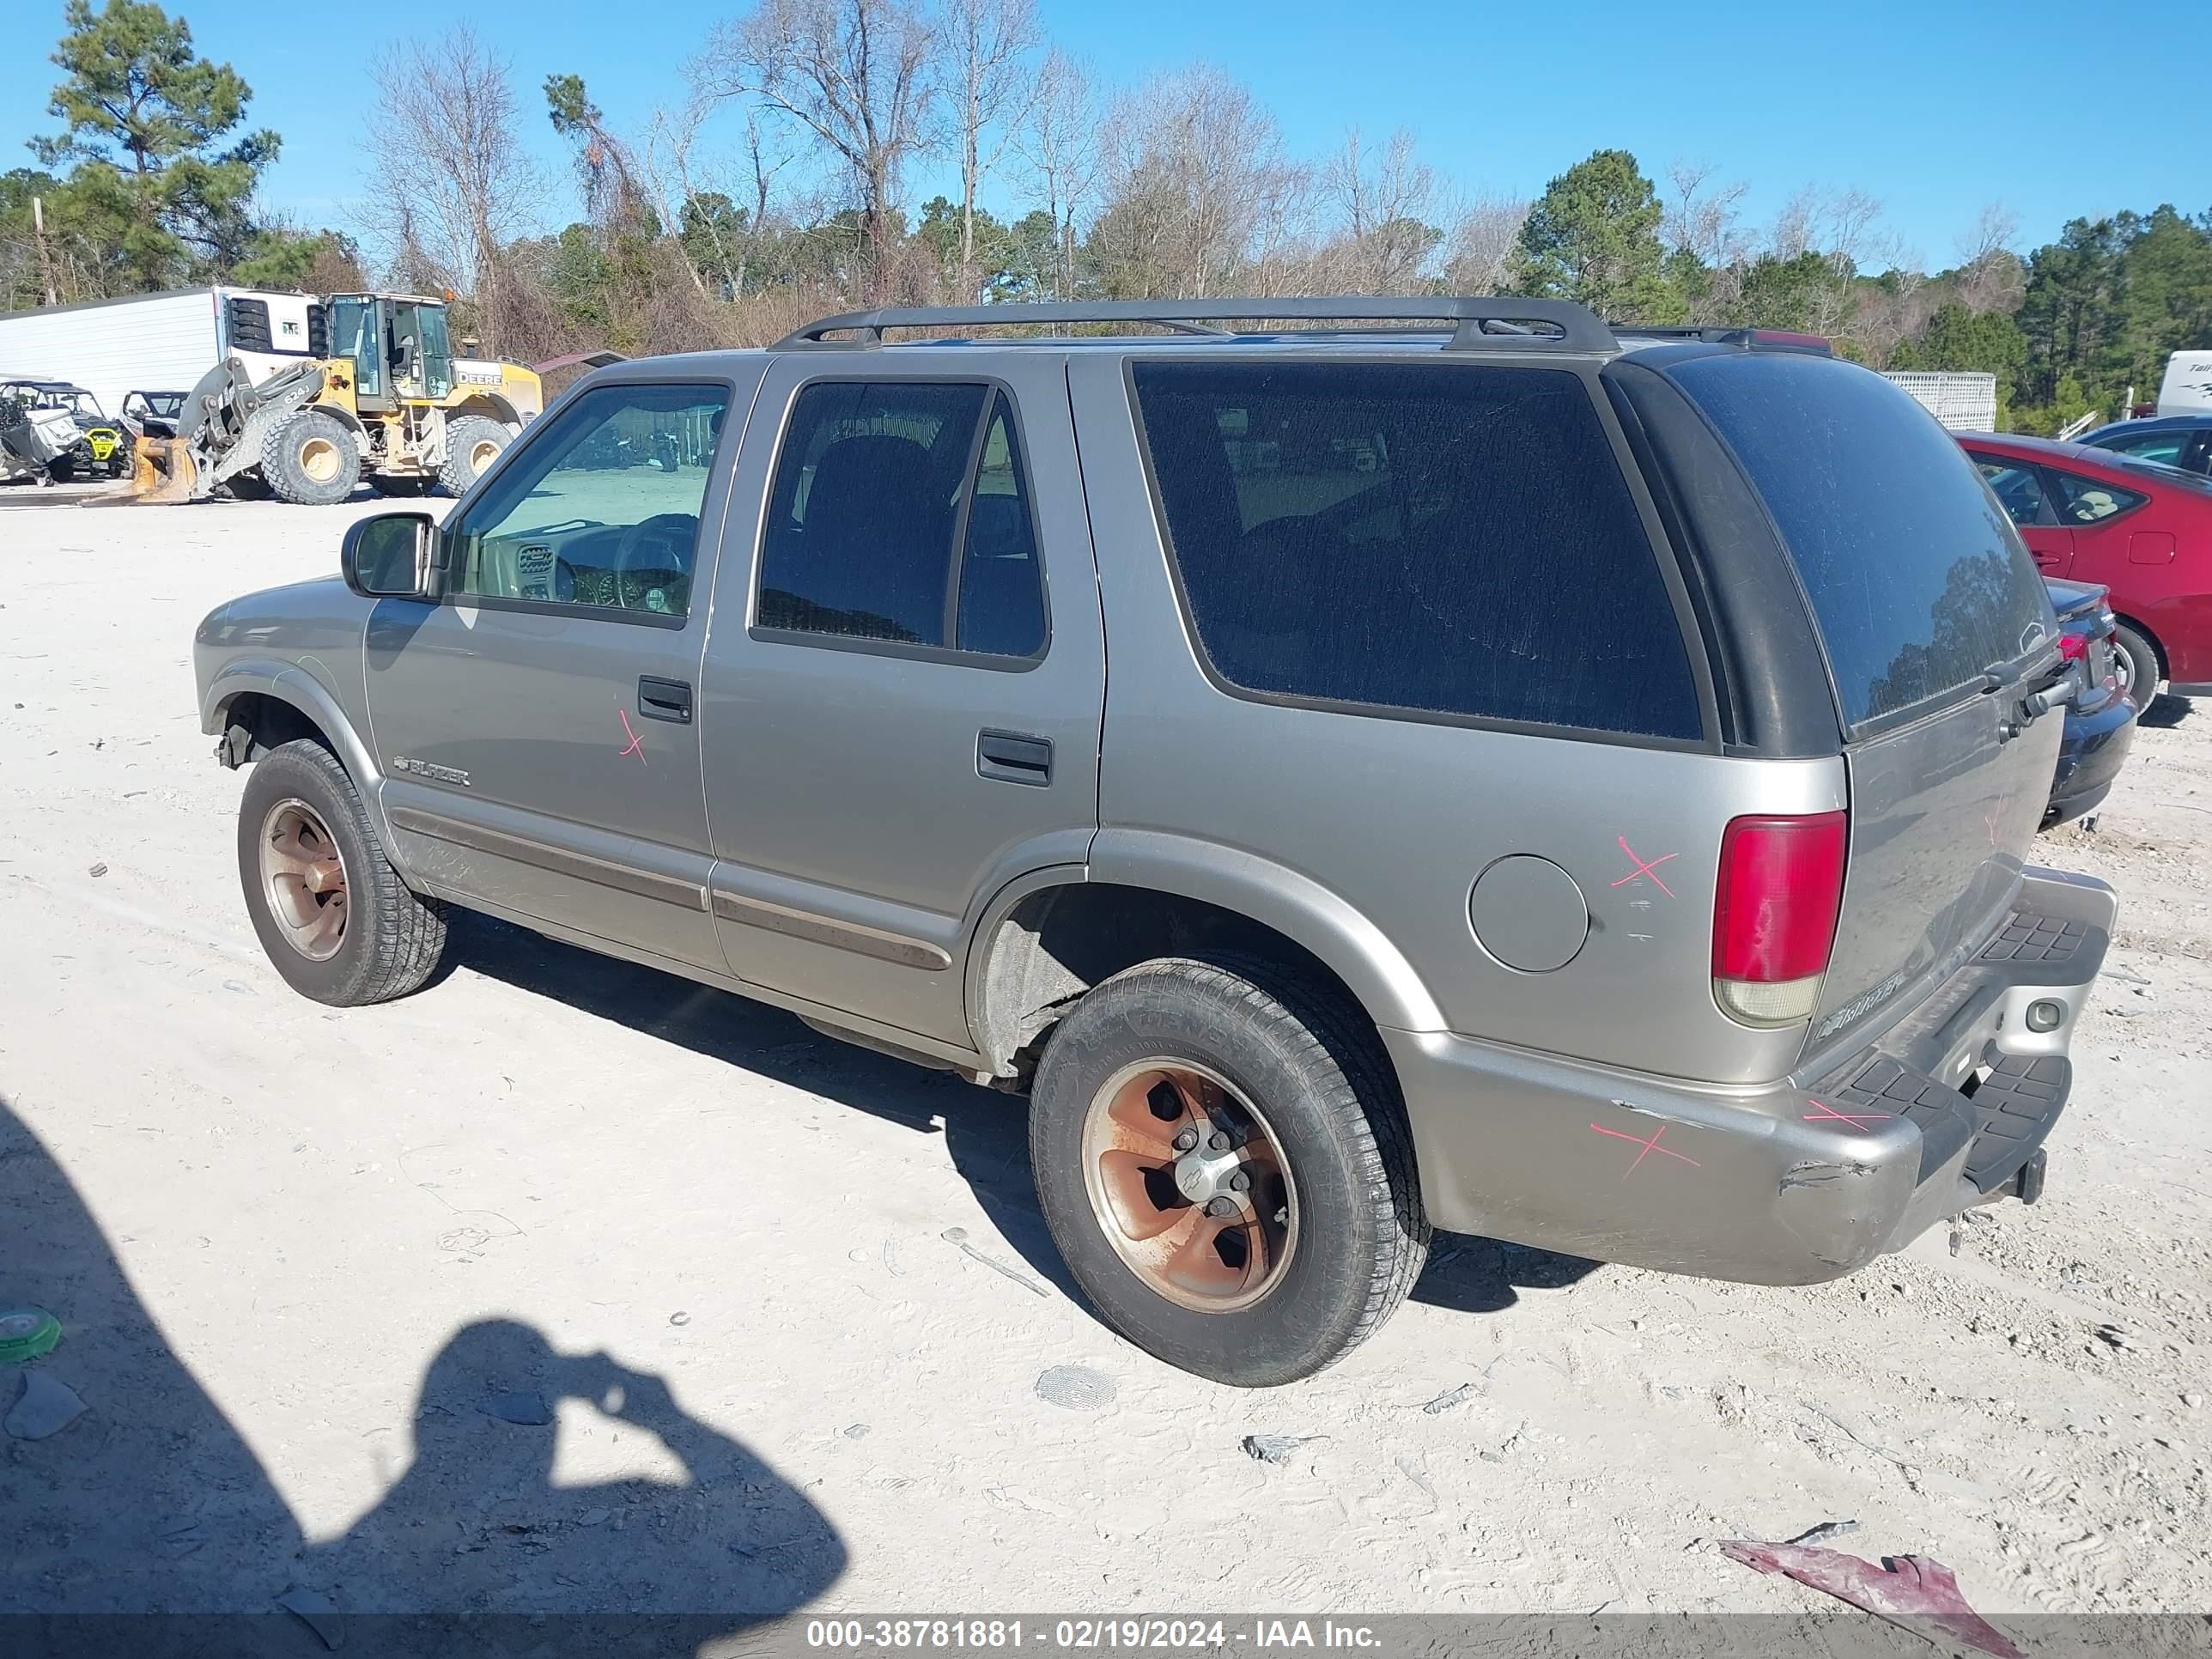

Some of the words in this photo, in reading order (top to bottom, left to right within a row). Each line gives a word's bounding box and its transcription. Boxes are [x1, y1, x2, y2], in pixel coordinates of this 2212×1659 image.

[459, 371, 501, 386] DEERE
[284, 385, 310, 404] 624J
[410, 759, 471, 785] BLAZER
